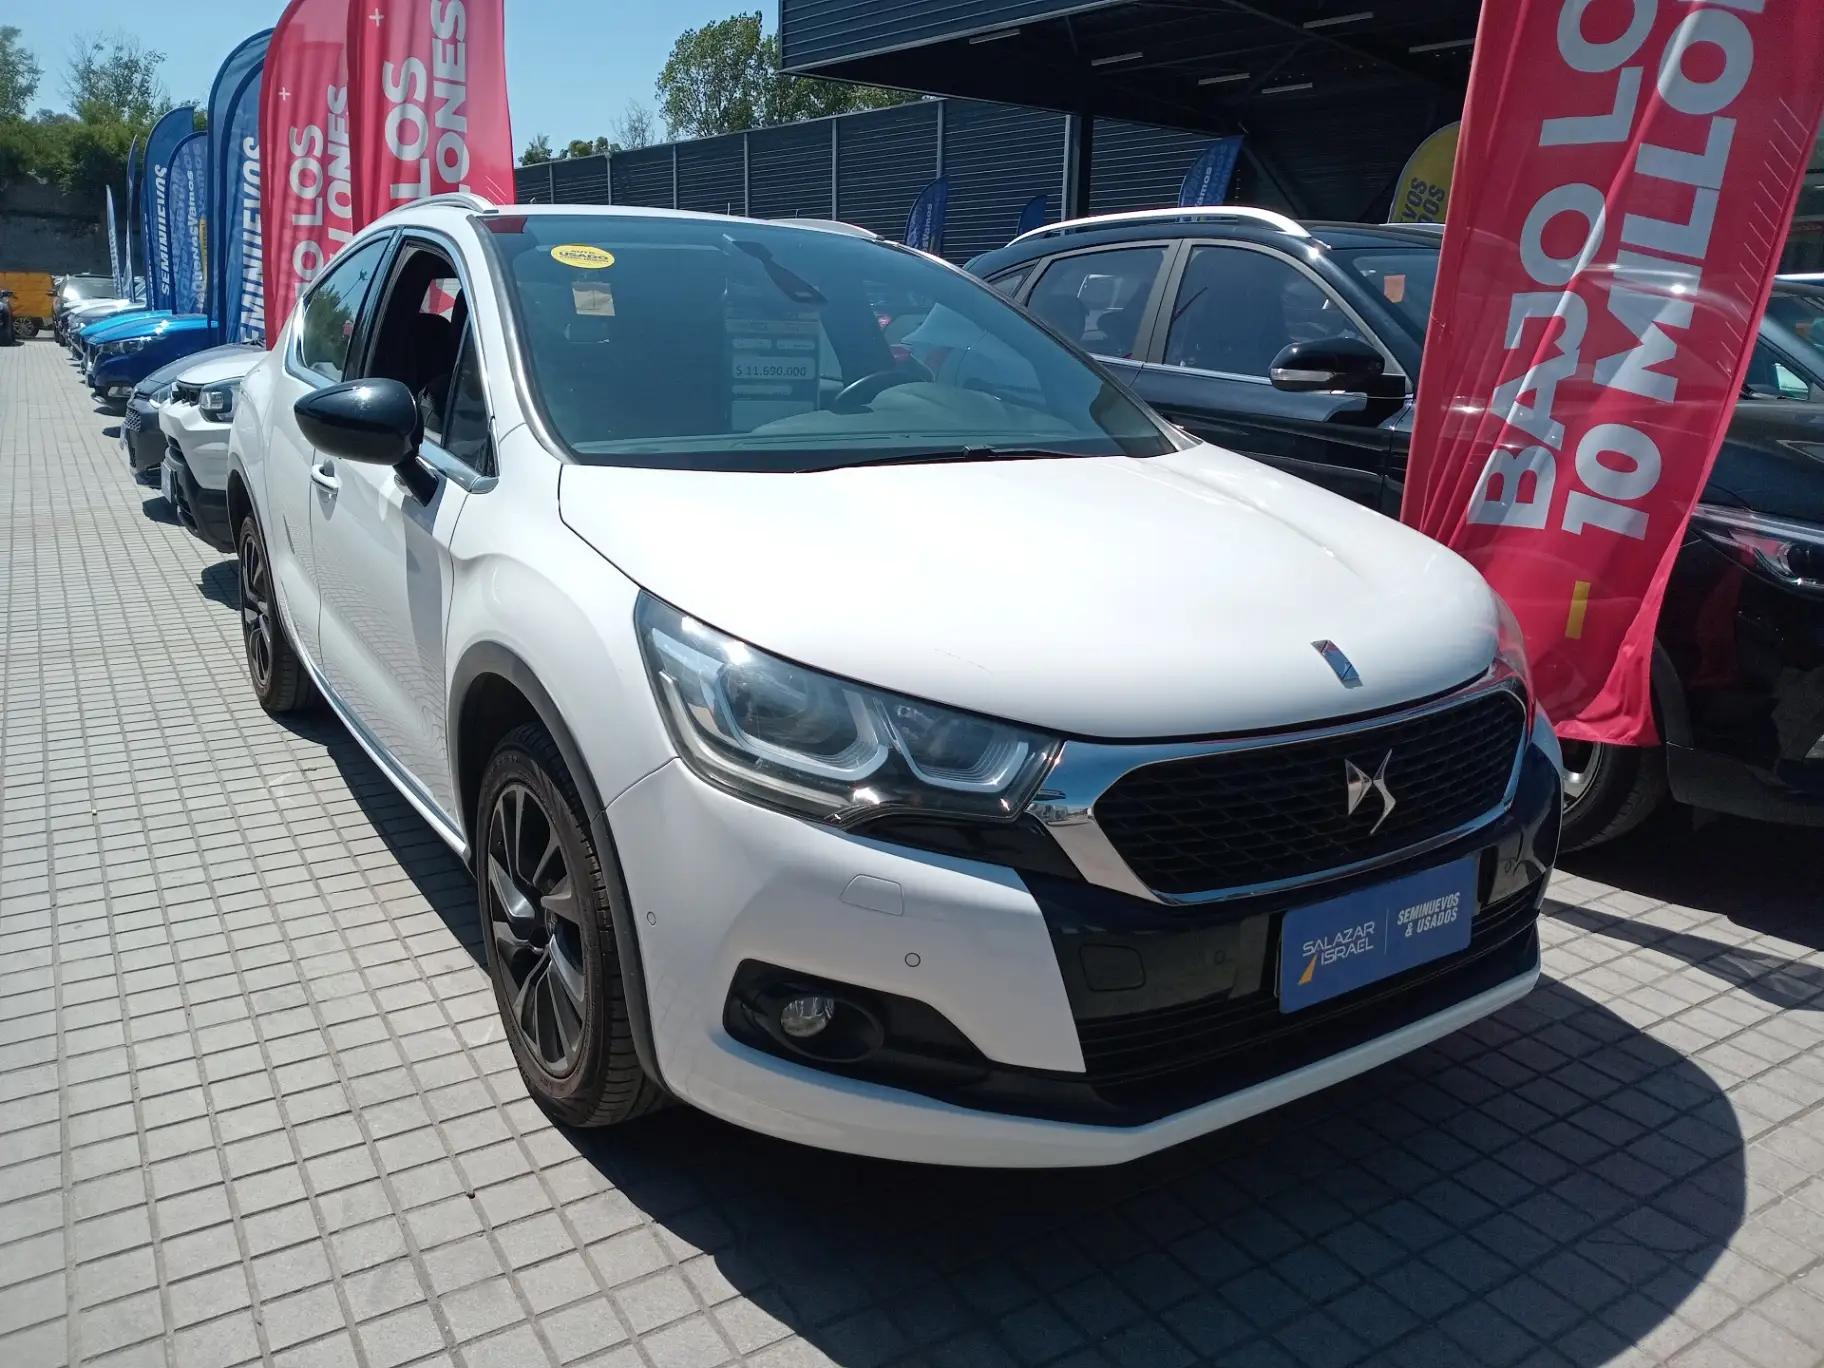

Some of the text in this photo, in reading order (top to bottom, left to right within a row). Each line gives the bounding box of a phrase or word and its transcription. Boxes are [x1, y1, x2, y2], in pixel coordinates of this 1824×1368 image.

[382, 56, 431, 199] LOS
[430, 0, 470, 193] ONES
[289, 124, 324, 226] LOS
[1401, 177, 1427, 220] VOS
[240, 136, 265, 343] EMINUEVOS
[1561, 0, 1766, 541] 10 MILLO
[1467, 183, 1606, 530] BAJO
[1302, 920, 1376, 958] SALAZAR
[1320, 938, 1374, 966] ISRAEL
[1396, 891, 1461, 926] SEMINUEVOS
[1404, 907, 1459, 938] & USADOS
